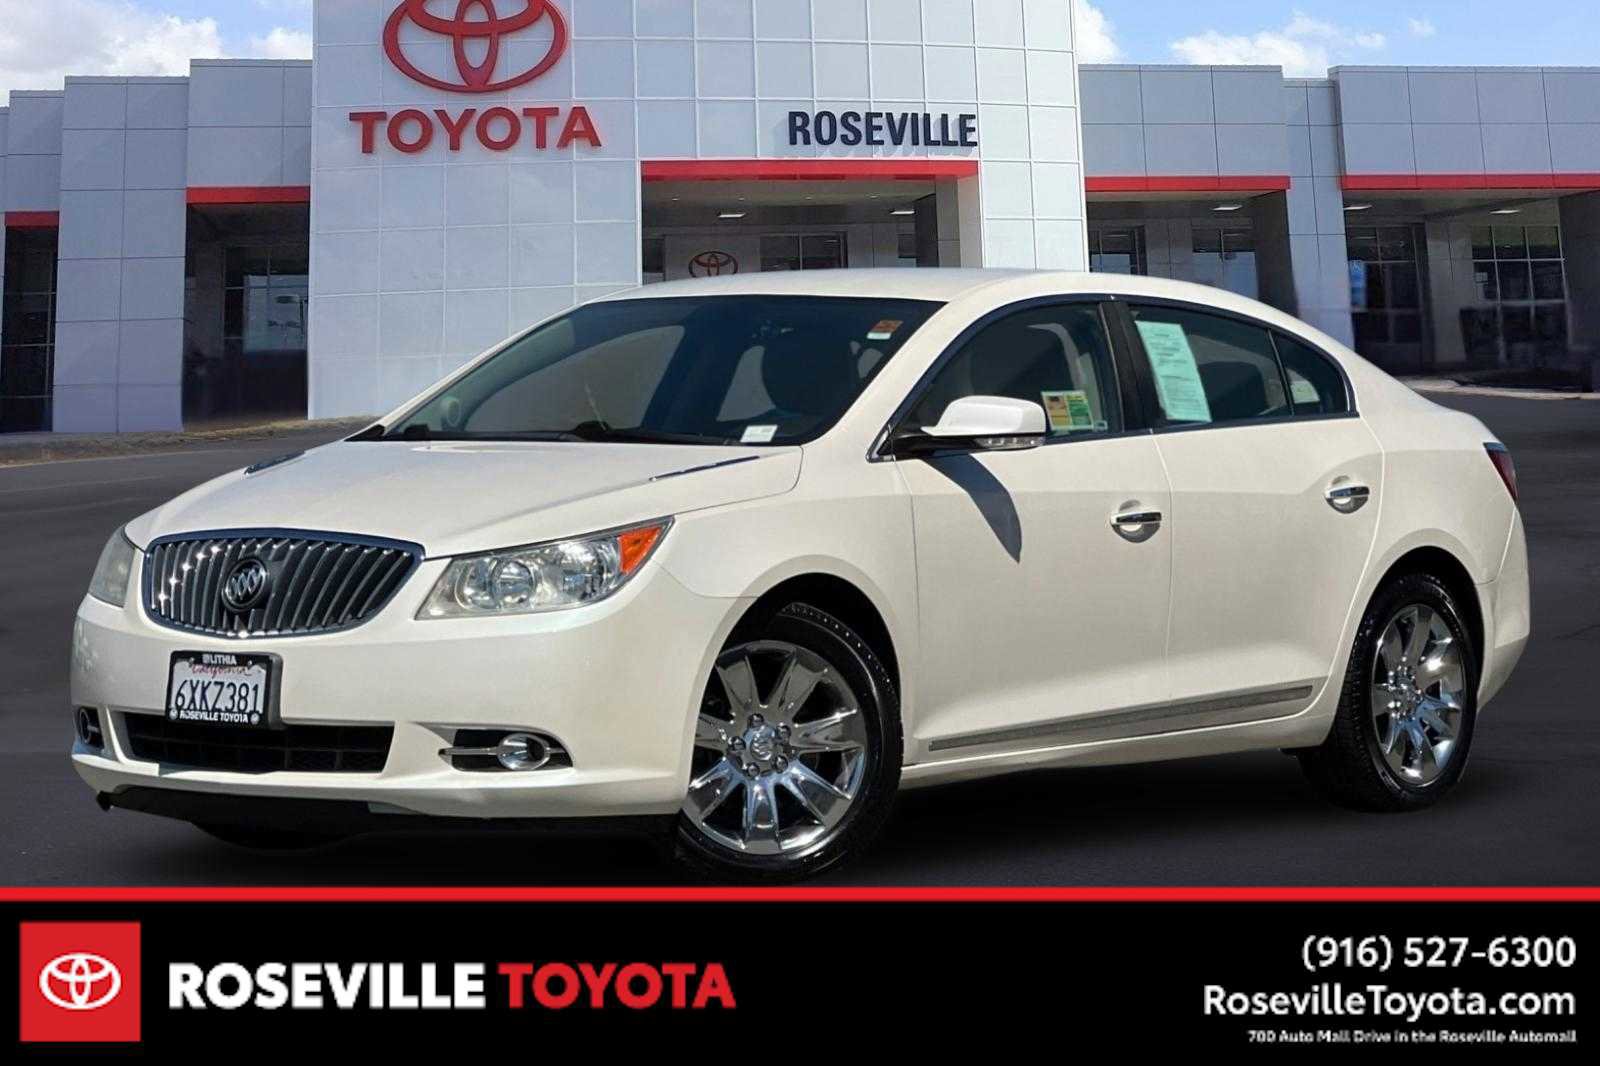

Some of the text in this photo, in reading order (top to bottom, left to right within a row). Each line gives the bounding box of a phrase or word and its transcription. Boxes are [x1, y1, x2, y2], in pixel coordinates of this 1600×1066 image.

[349, 105, 603, 155] TOYOTA
[788, 111, 978, 148] ROSEVILLE
[174, 679, 259, 713] 6XKZ381
[180, 709, 249, 723] ROSEVILLE TOYOTA
